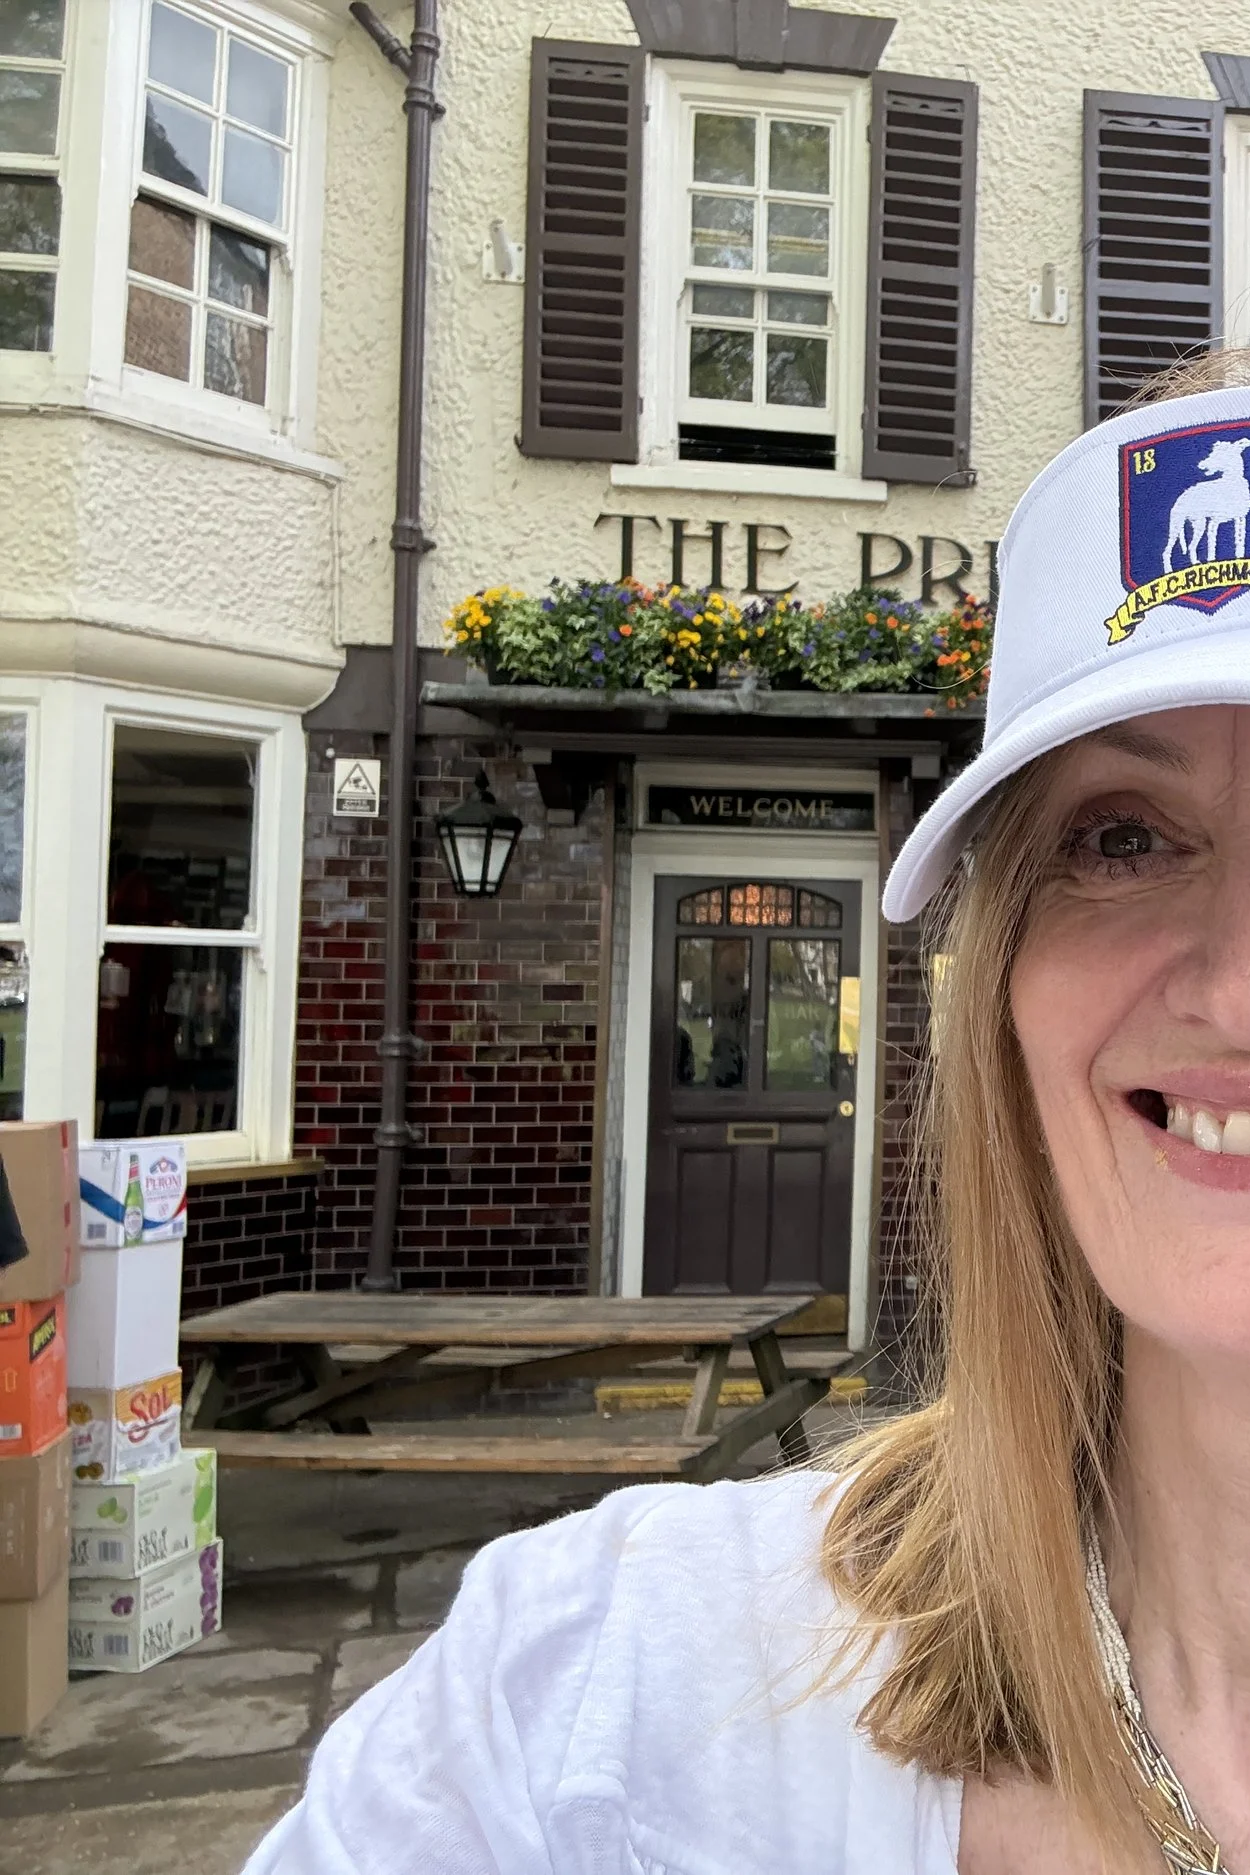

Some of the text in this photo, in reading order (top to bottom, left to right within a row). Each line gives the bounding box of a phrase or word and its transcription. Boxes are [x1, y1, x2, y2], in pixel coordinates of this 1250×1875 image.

[1133, 449, 1156, 475] 18
[593, 512, 800, 594] THE
[690, 795, 834, 819] WELCOME
